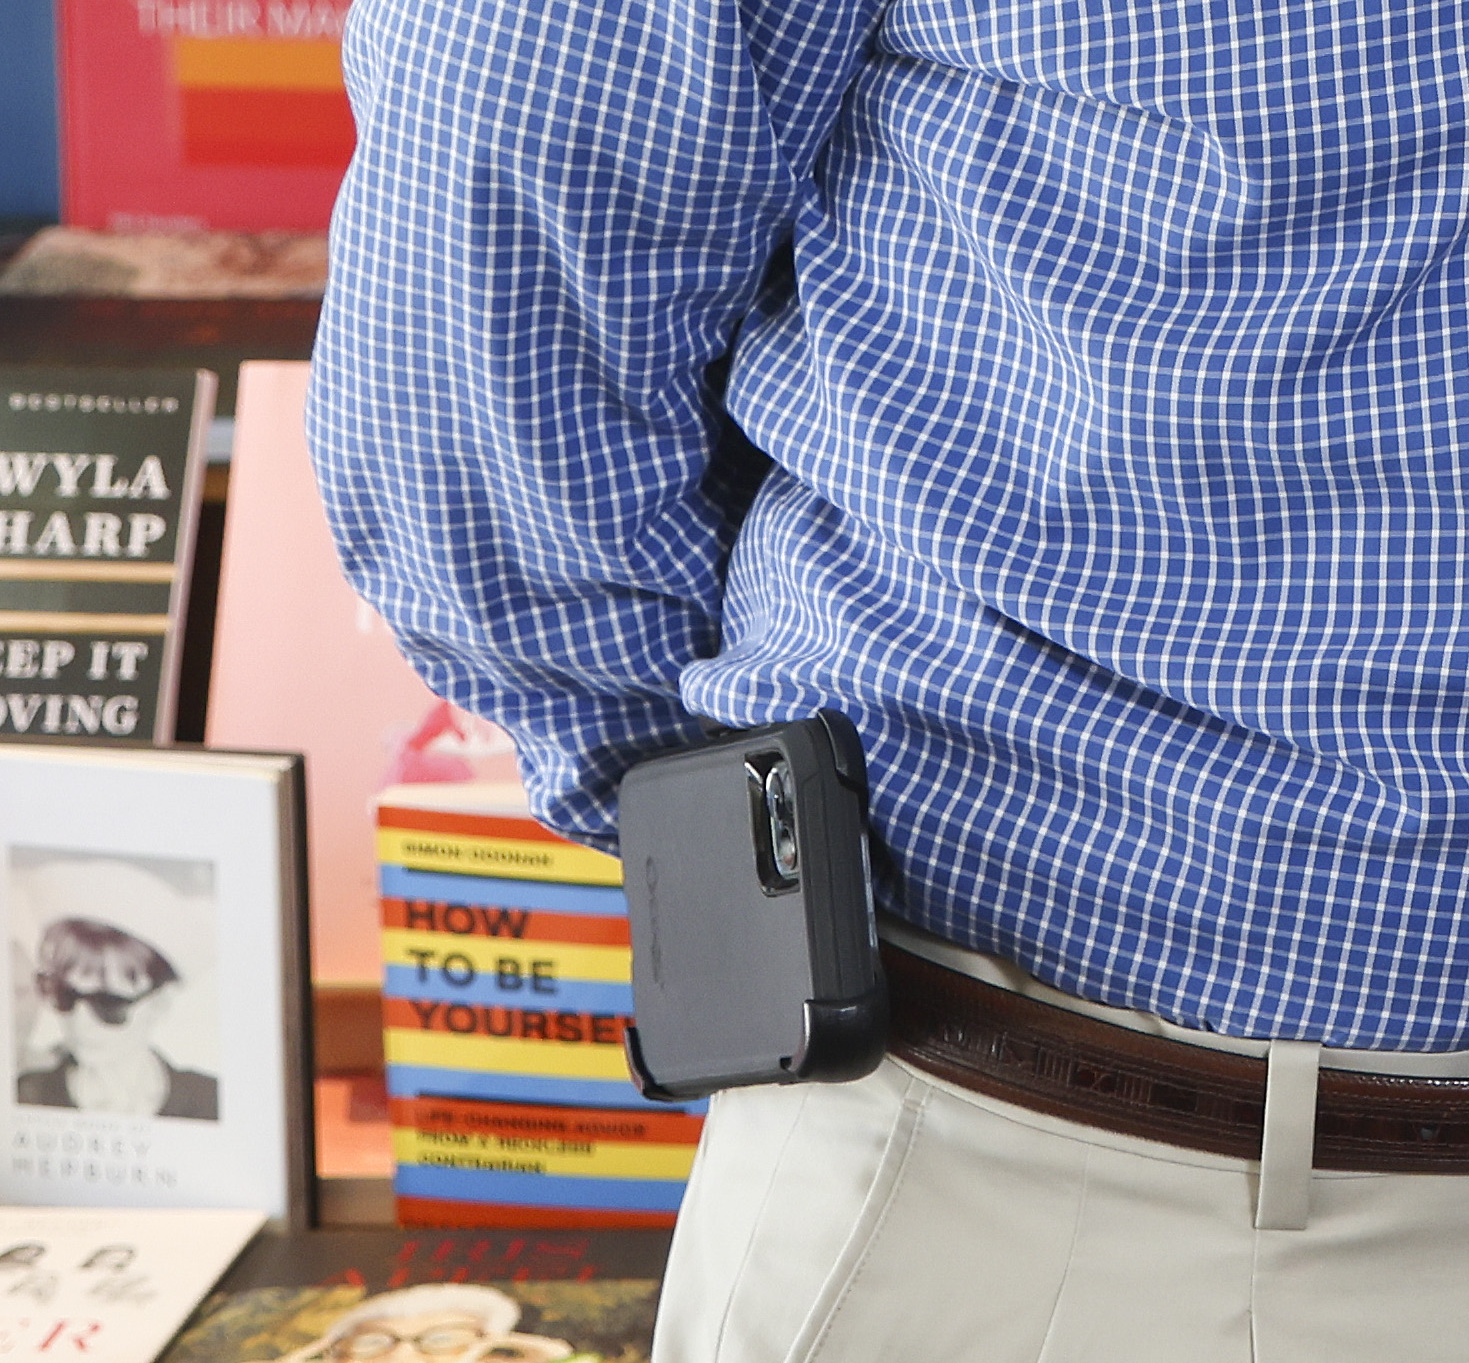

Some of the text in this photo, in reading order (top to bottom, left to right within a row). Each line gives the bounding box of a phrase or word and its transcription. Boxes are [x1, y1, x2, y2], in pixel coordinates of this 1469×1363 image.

[0, 451, 172, 500] WYLA
[0, 509, 167, 558] HARP
[0, 639, 150, 682] EP IT
[403, 898, 530, 941] HOW
[406, 947, 558, 995] TO BE
[408, 1000, 635, 1046] YOURSE
[11, 1157, 180, 1190] HEPBURN
